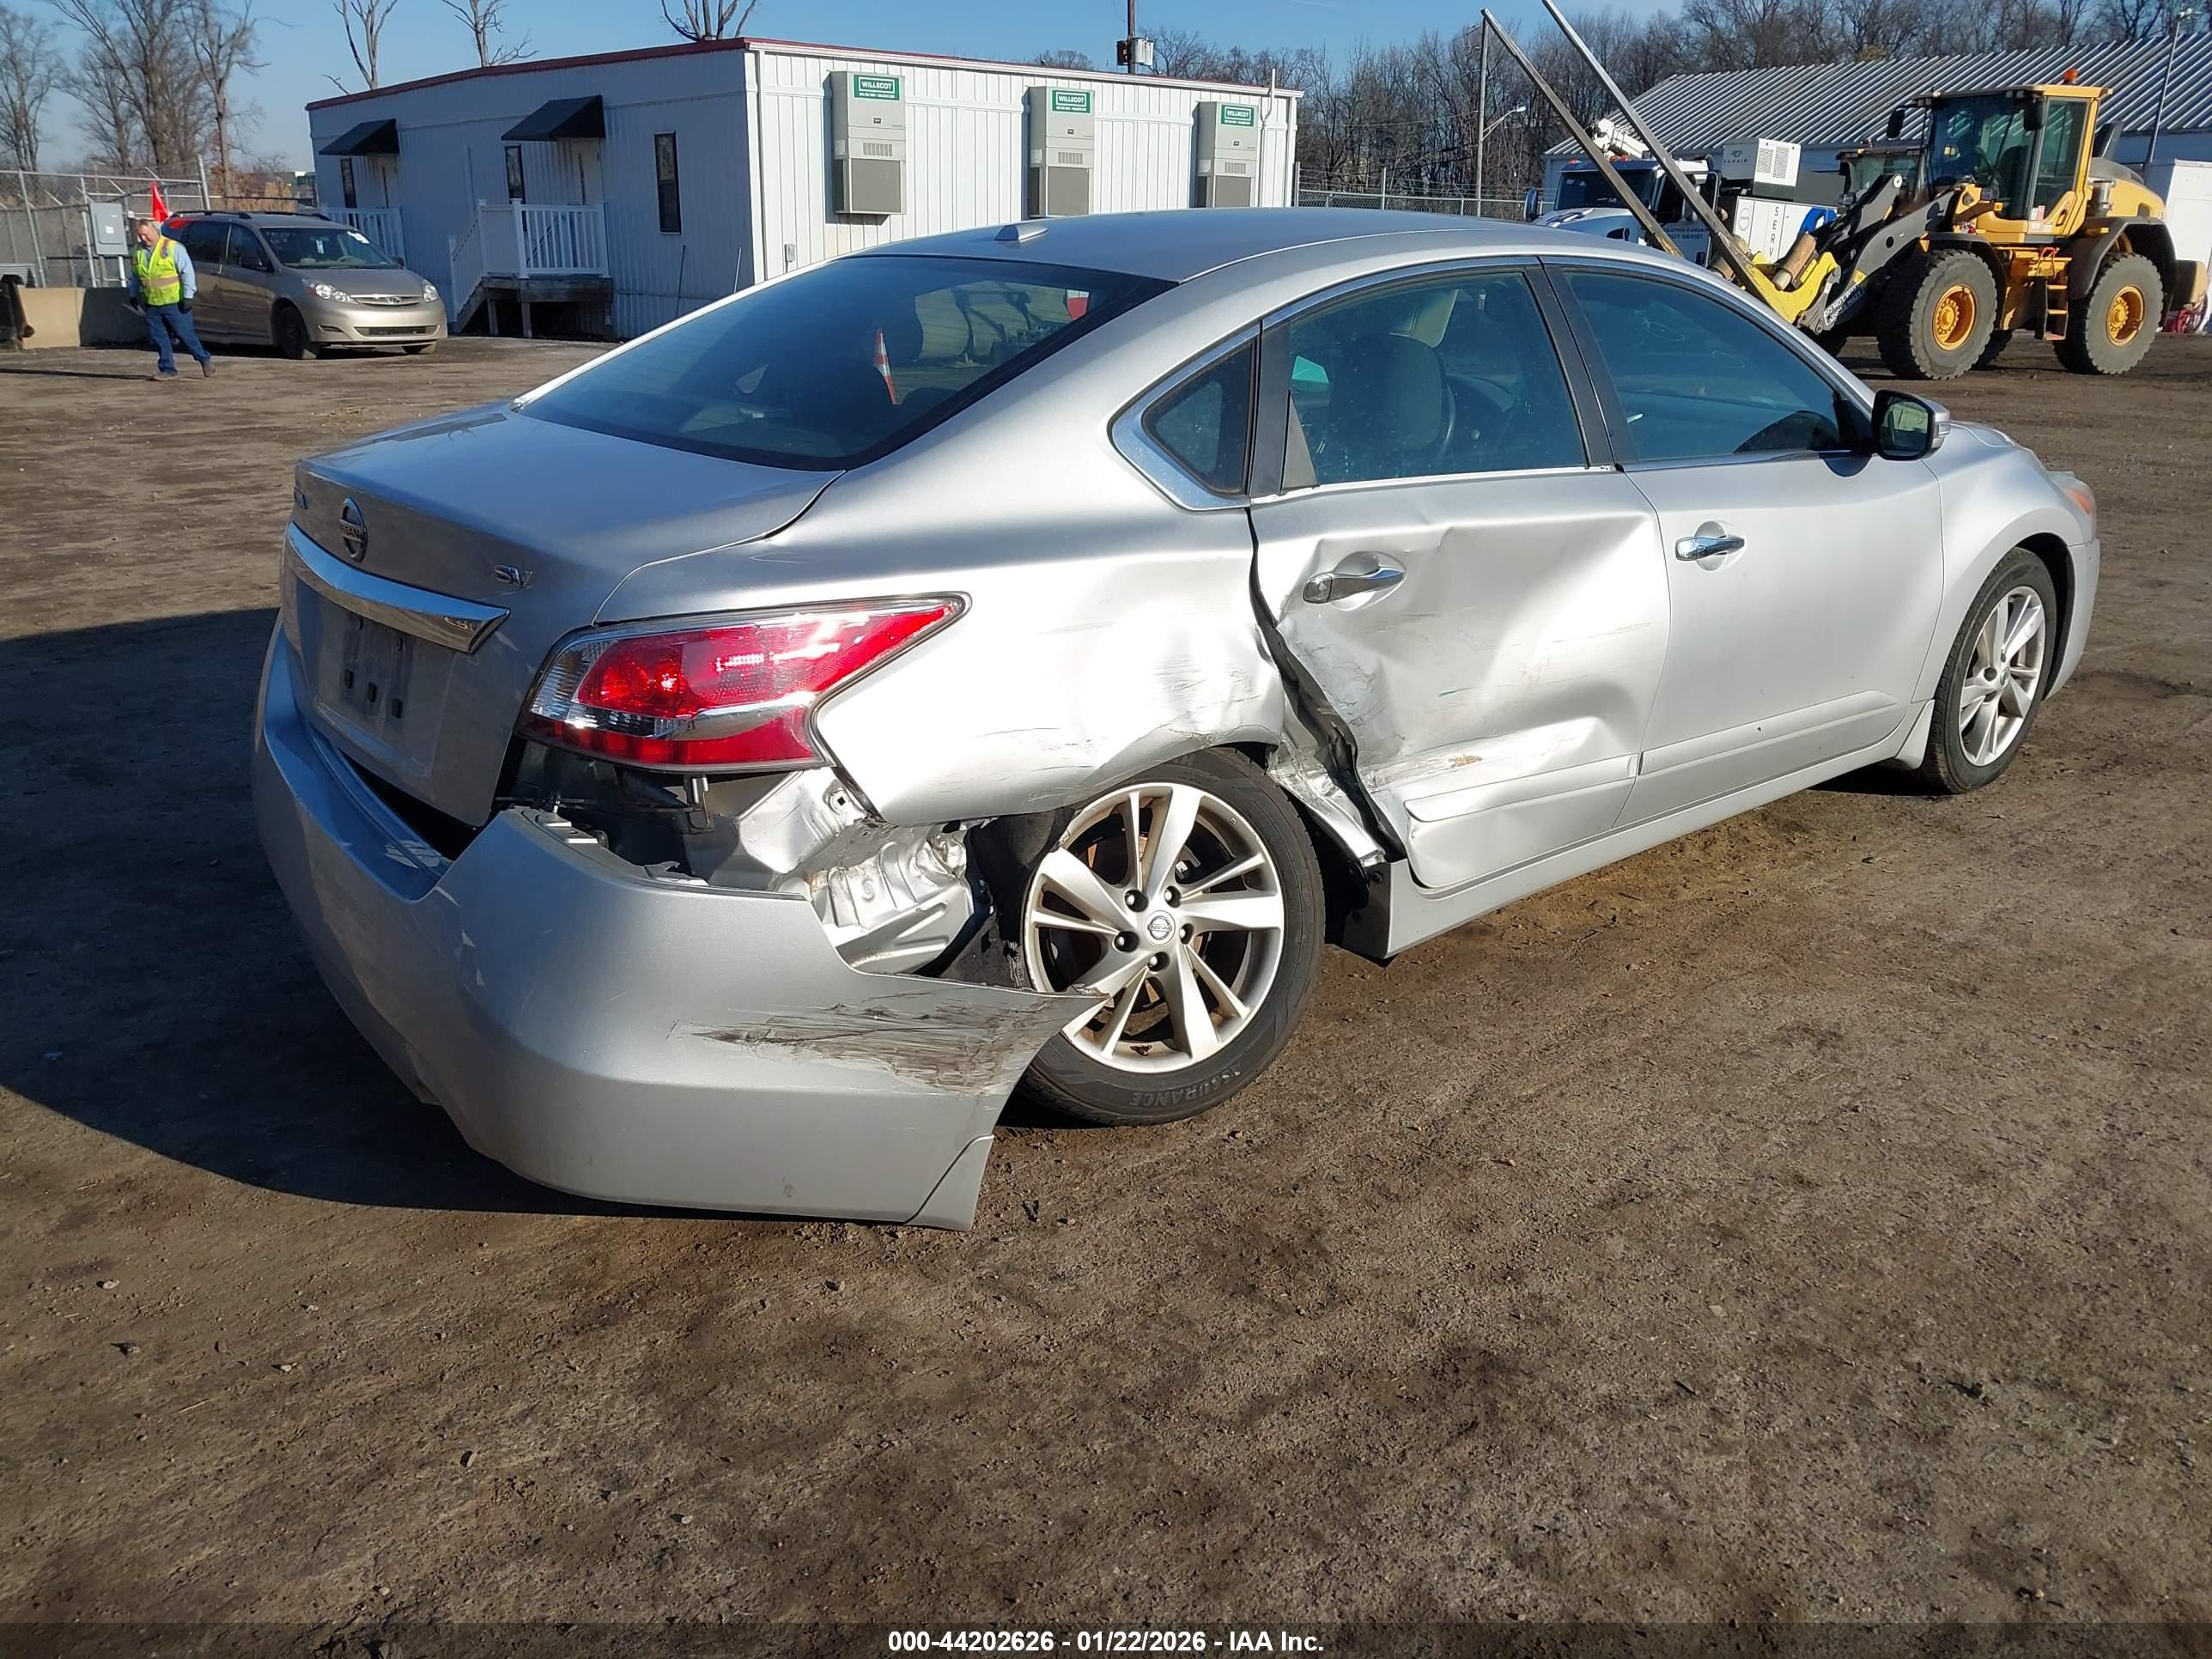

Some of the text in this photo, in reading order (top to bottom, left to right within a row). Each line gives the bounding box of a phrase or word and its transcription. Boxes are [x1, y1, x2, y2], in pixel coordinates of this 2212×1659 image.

[861, 81, 893, 90] WILLSCOT
[1058, 95, 1085, 104] WILLSCOT
[494, 563, 533, 588] SV
